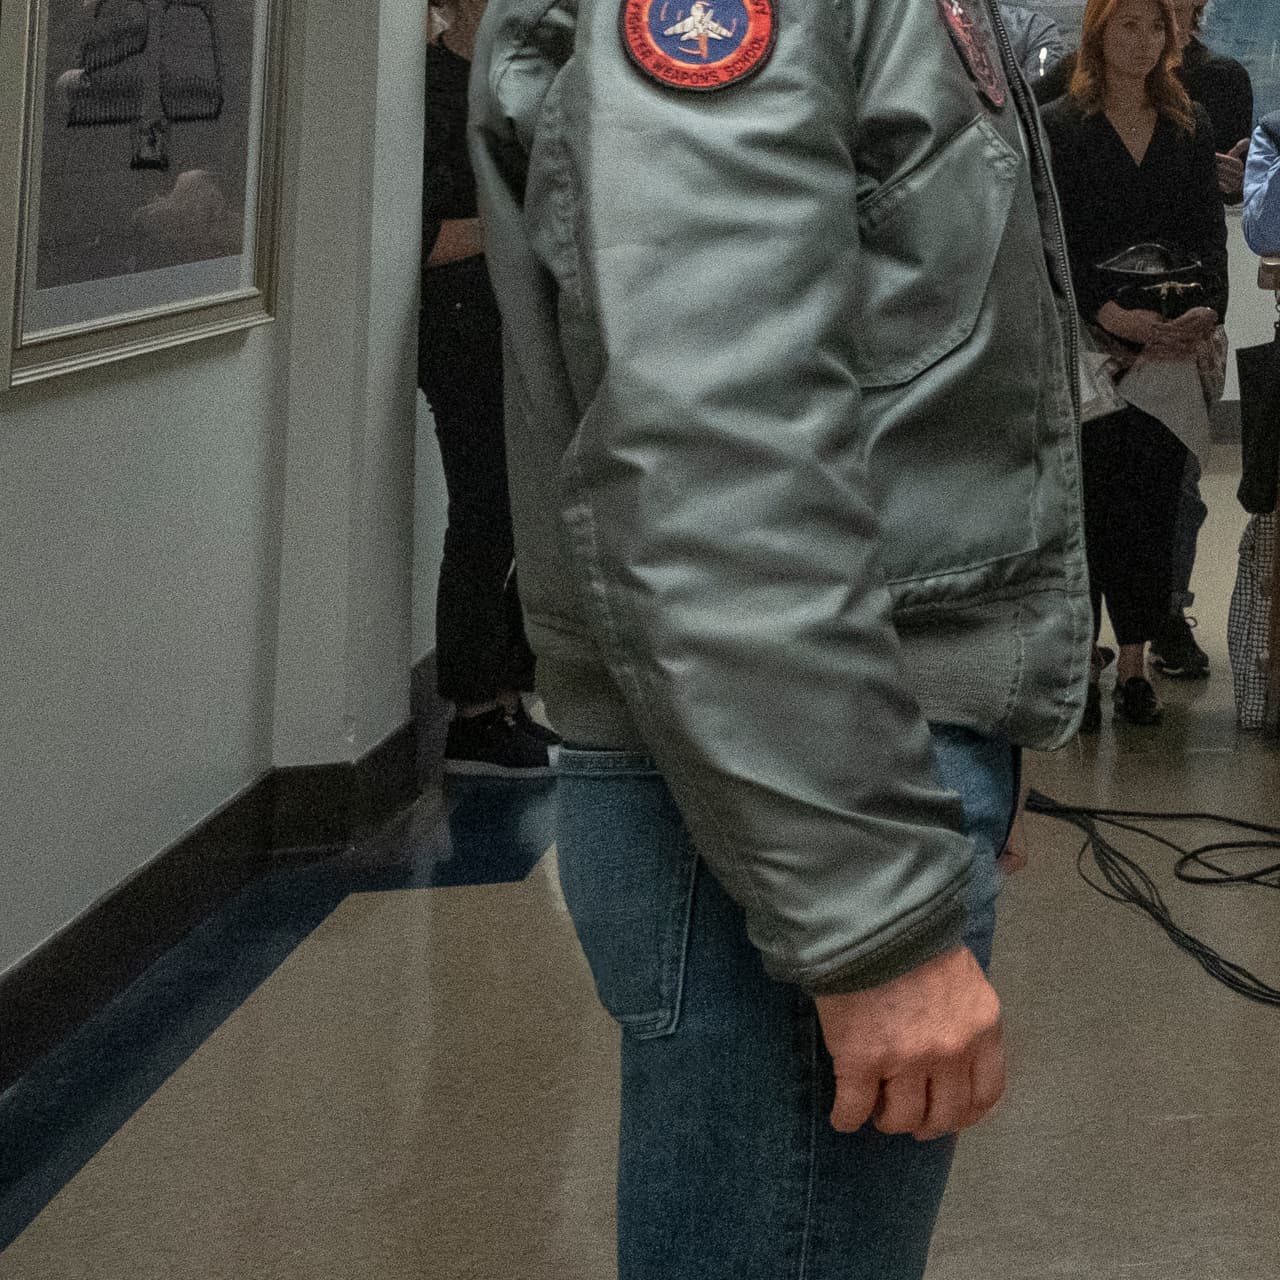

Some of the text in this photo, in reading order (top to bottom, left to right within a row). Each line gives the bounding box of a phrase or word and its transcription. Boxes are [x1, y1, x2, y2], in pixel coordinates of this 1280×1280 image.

[629, 2, 765, 83] FIGHTER WEAPONS SCHOOL
